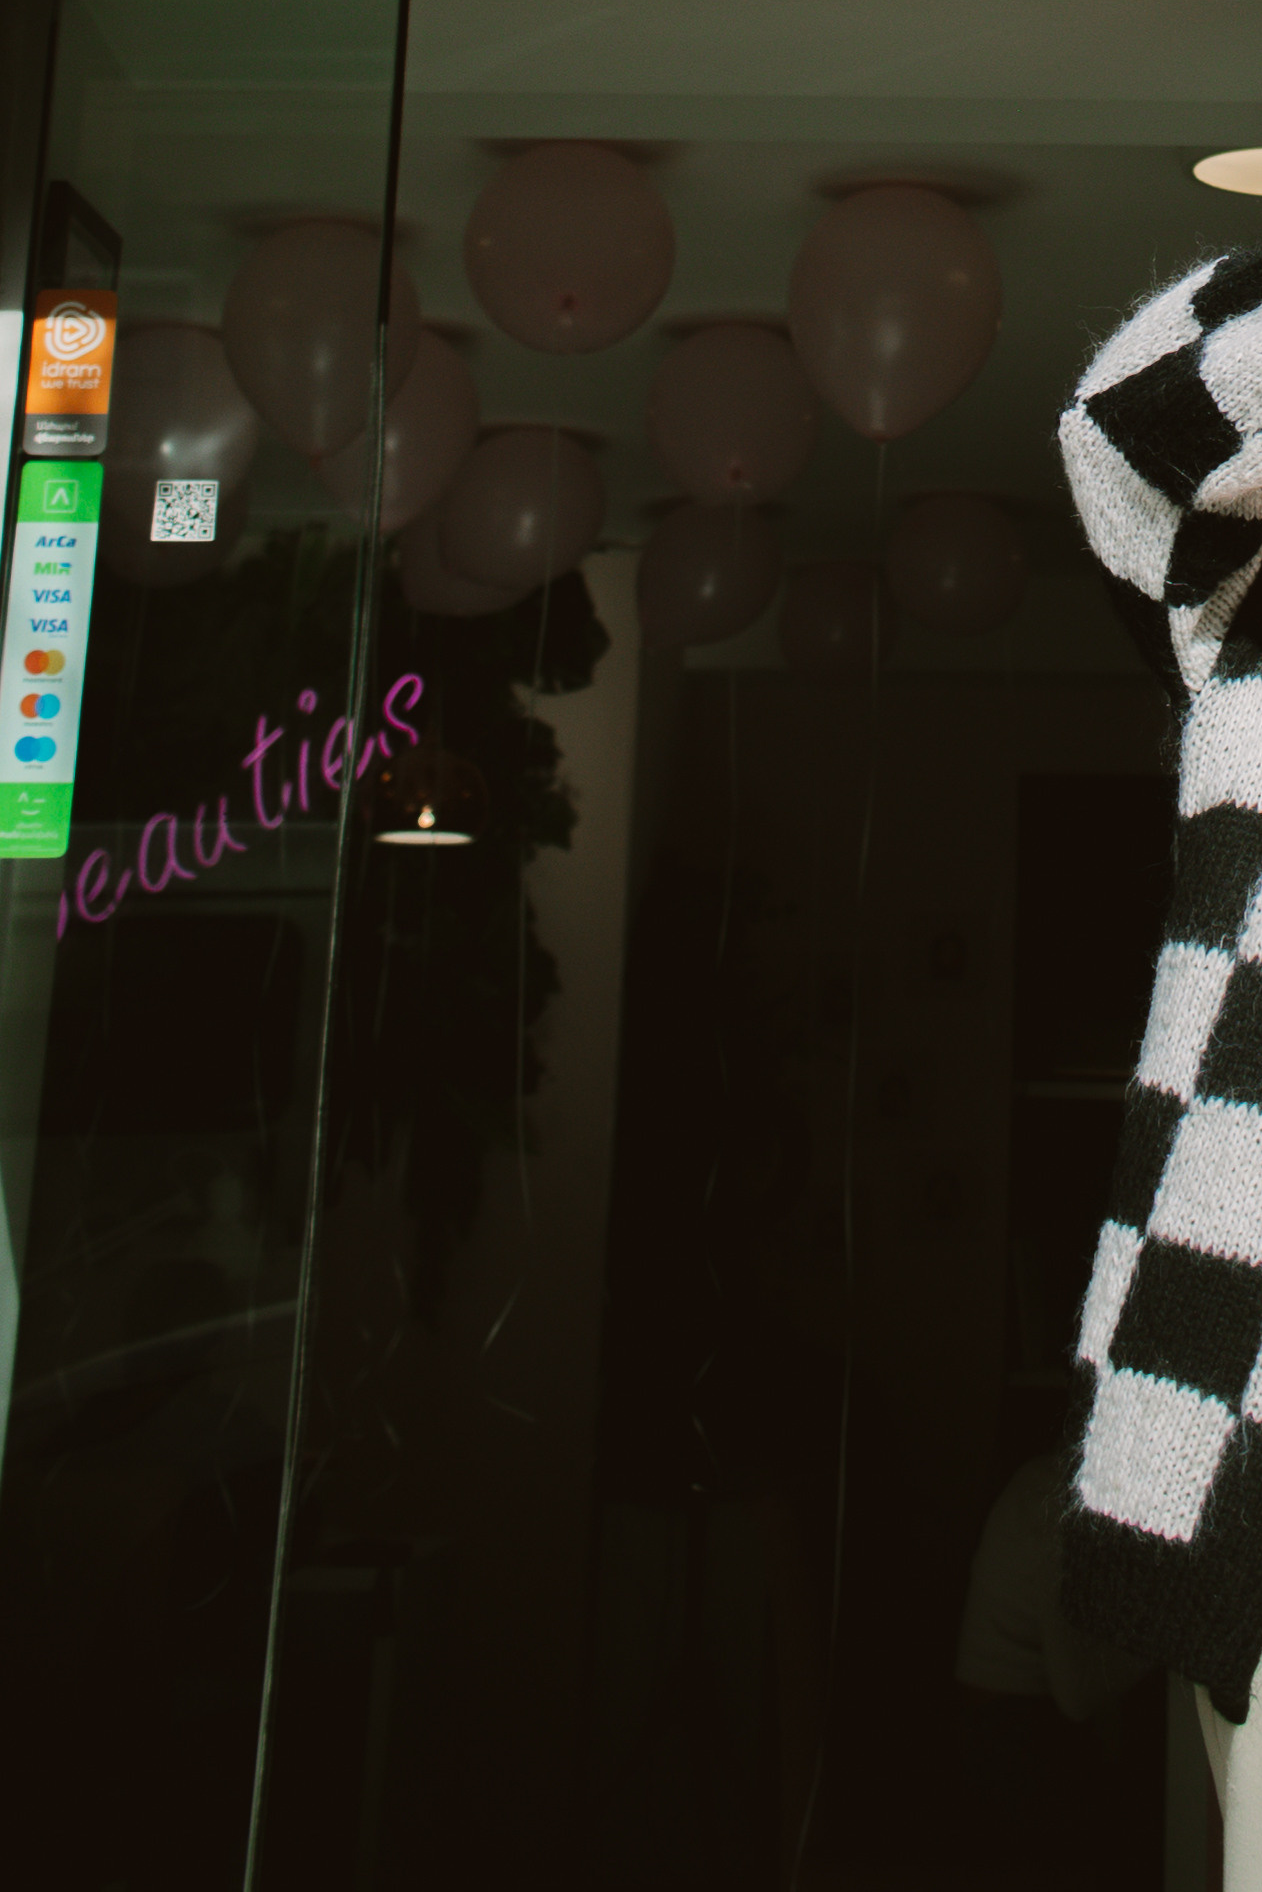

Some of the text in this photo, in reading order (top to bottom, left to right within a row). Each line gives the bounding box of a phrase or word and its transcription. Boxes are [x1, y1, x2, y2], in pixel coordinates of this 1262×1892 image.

[41, 359, 102, 378] idram
[41, 378, 100, 389] we trust
[34, 535, 78, 548] ArCa
[32, 589, 72, 603] VISA
[29, 618, 69, 633] VISA
[57, 673, 424, 942] eauties
